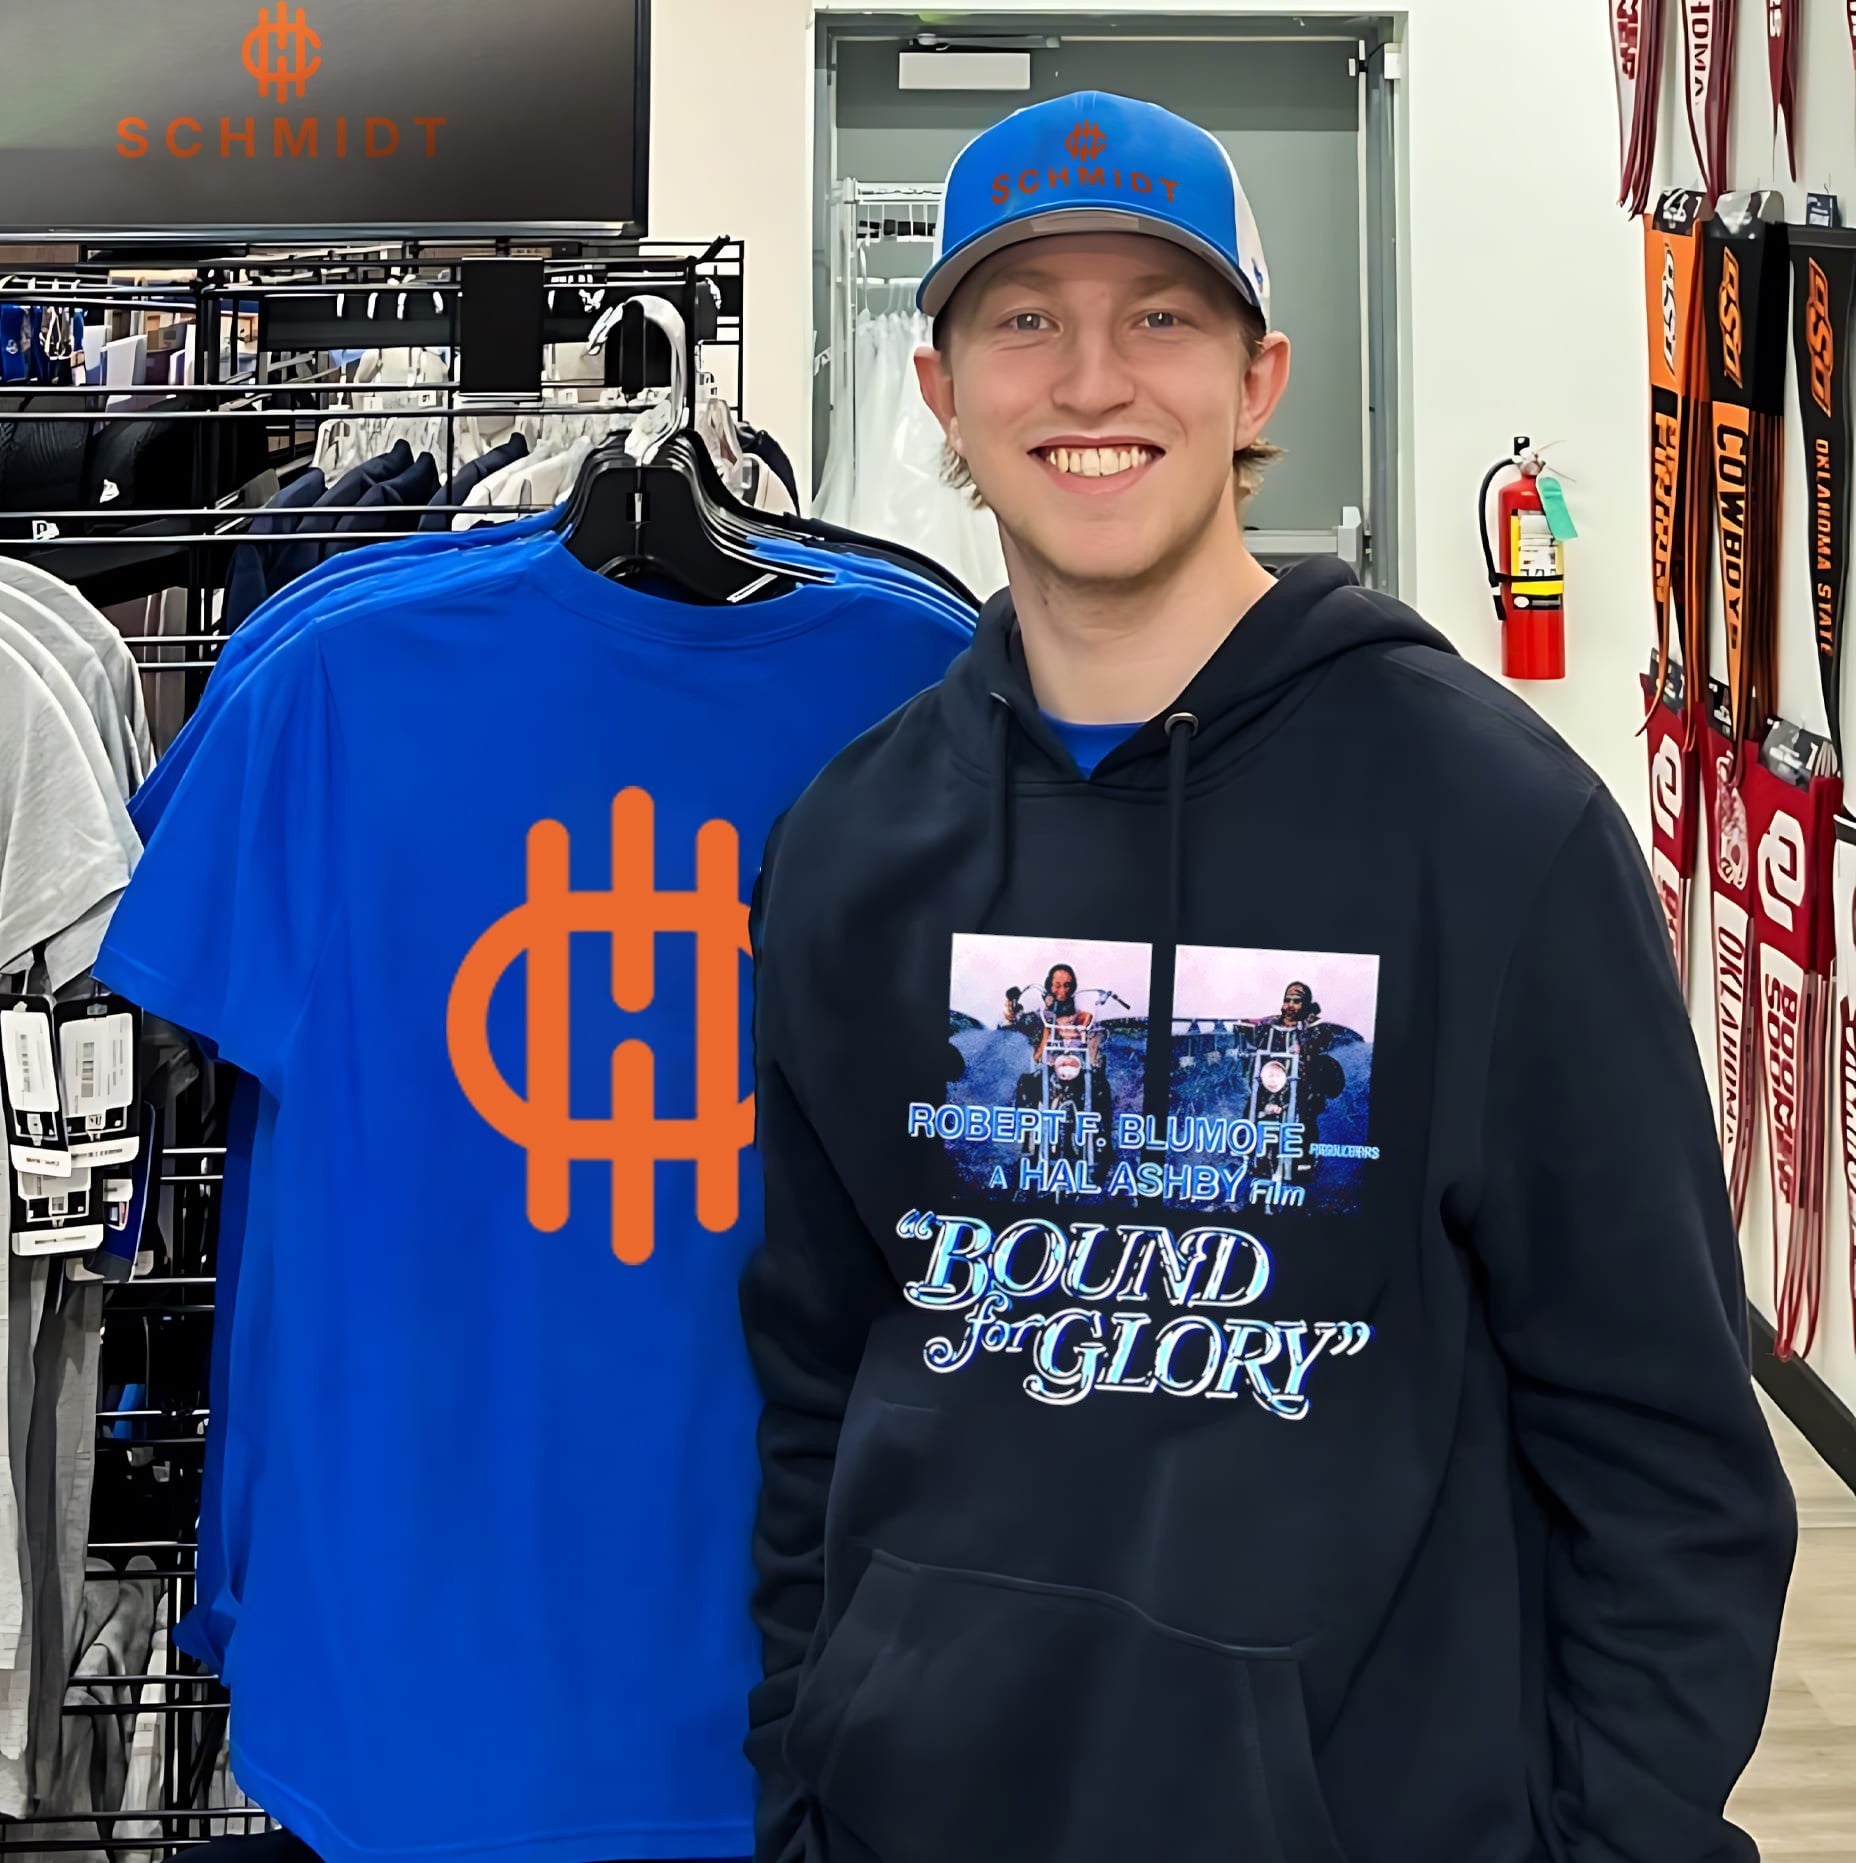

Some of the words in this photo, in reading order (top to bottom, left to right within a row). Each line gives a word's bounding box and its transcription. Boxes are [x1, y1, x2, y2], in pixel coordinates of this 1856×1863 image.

[115, 116, 448, 158] SCHMIDT
[991, 167, 1179, 205] SCHMIDT
[1816, 439, 1832, 570] OKLAHOMA
[1817, 583, 1833, 656] STATE
[1718, 926, 1745, 1144] OKLAHOMA
[908, 1102, 1067, 1144] ROBERT
[1074, 1112, 1107, 1147] F.
[1118, 1113, 1306, 1158] BLUMOFE
[988, 1165, 1008, 1189] A
[1019, 1157, 1102, 1194] HAL
[1108, 1160, 1248, 1203] ASHBY
[1250, 1178, 1306, 1207] Film
[923, 1289, 1046, 1374] for
